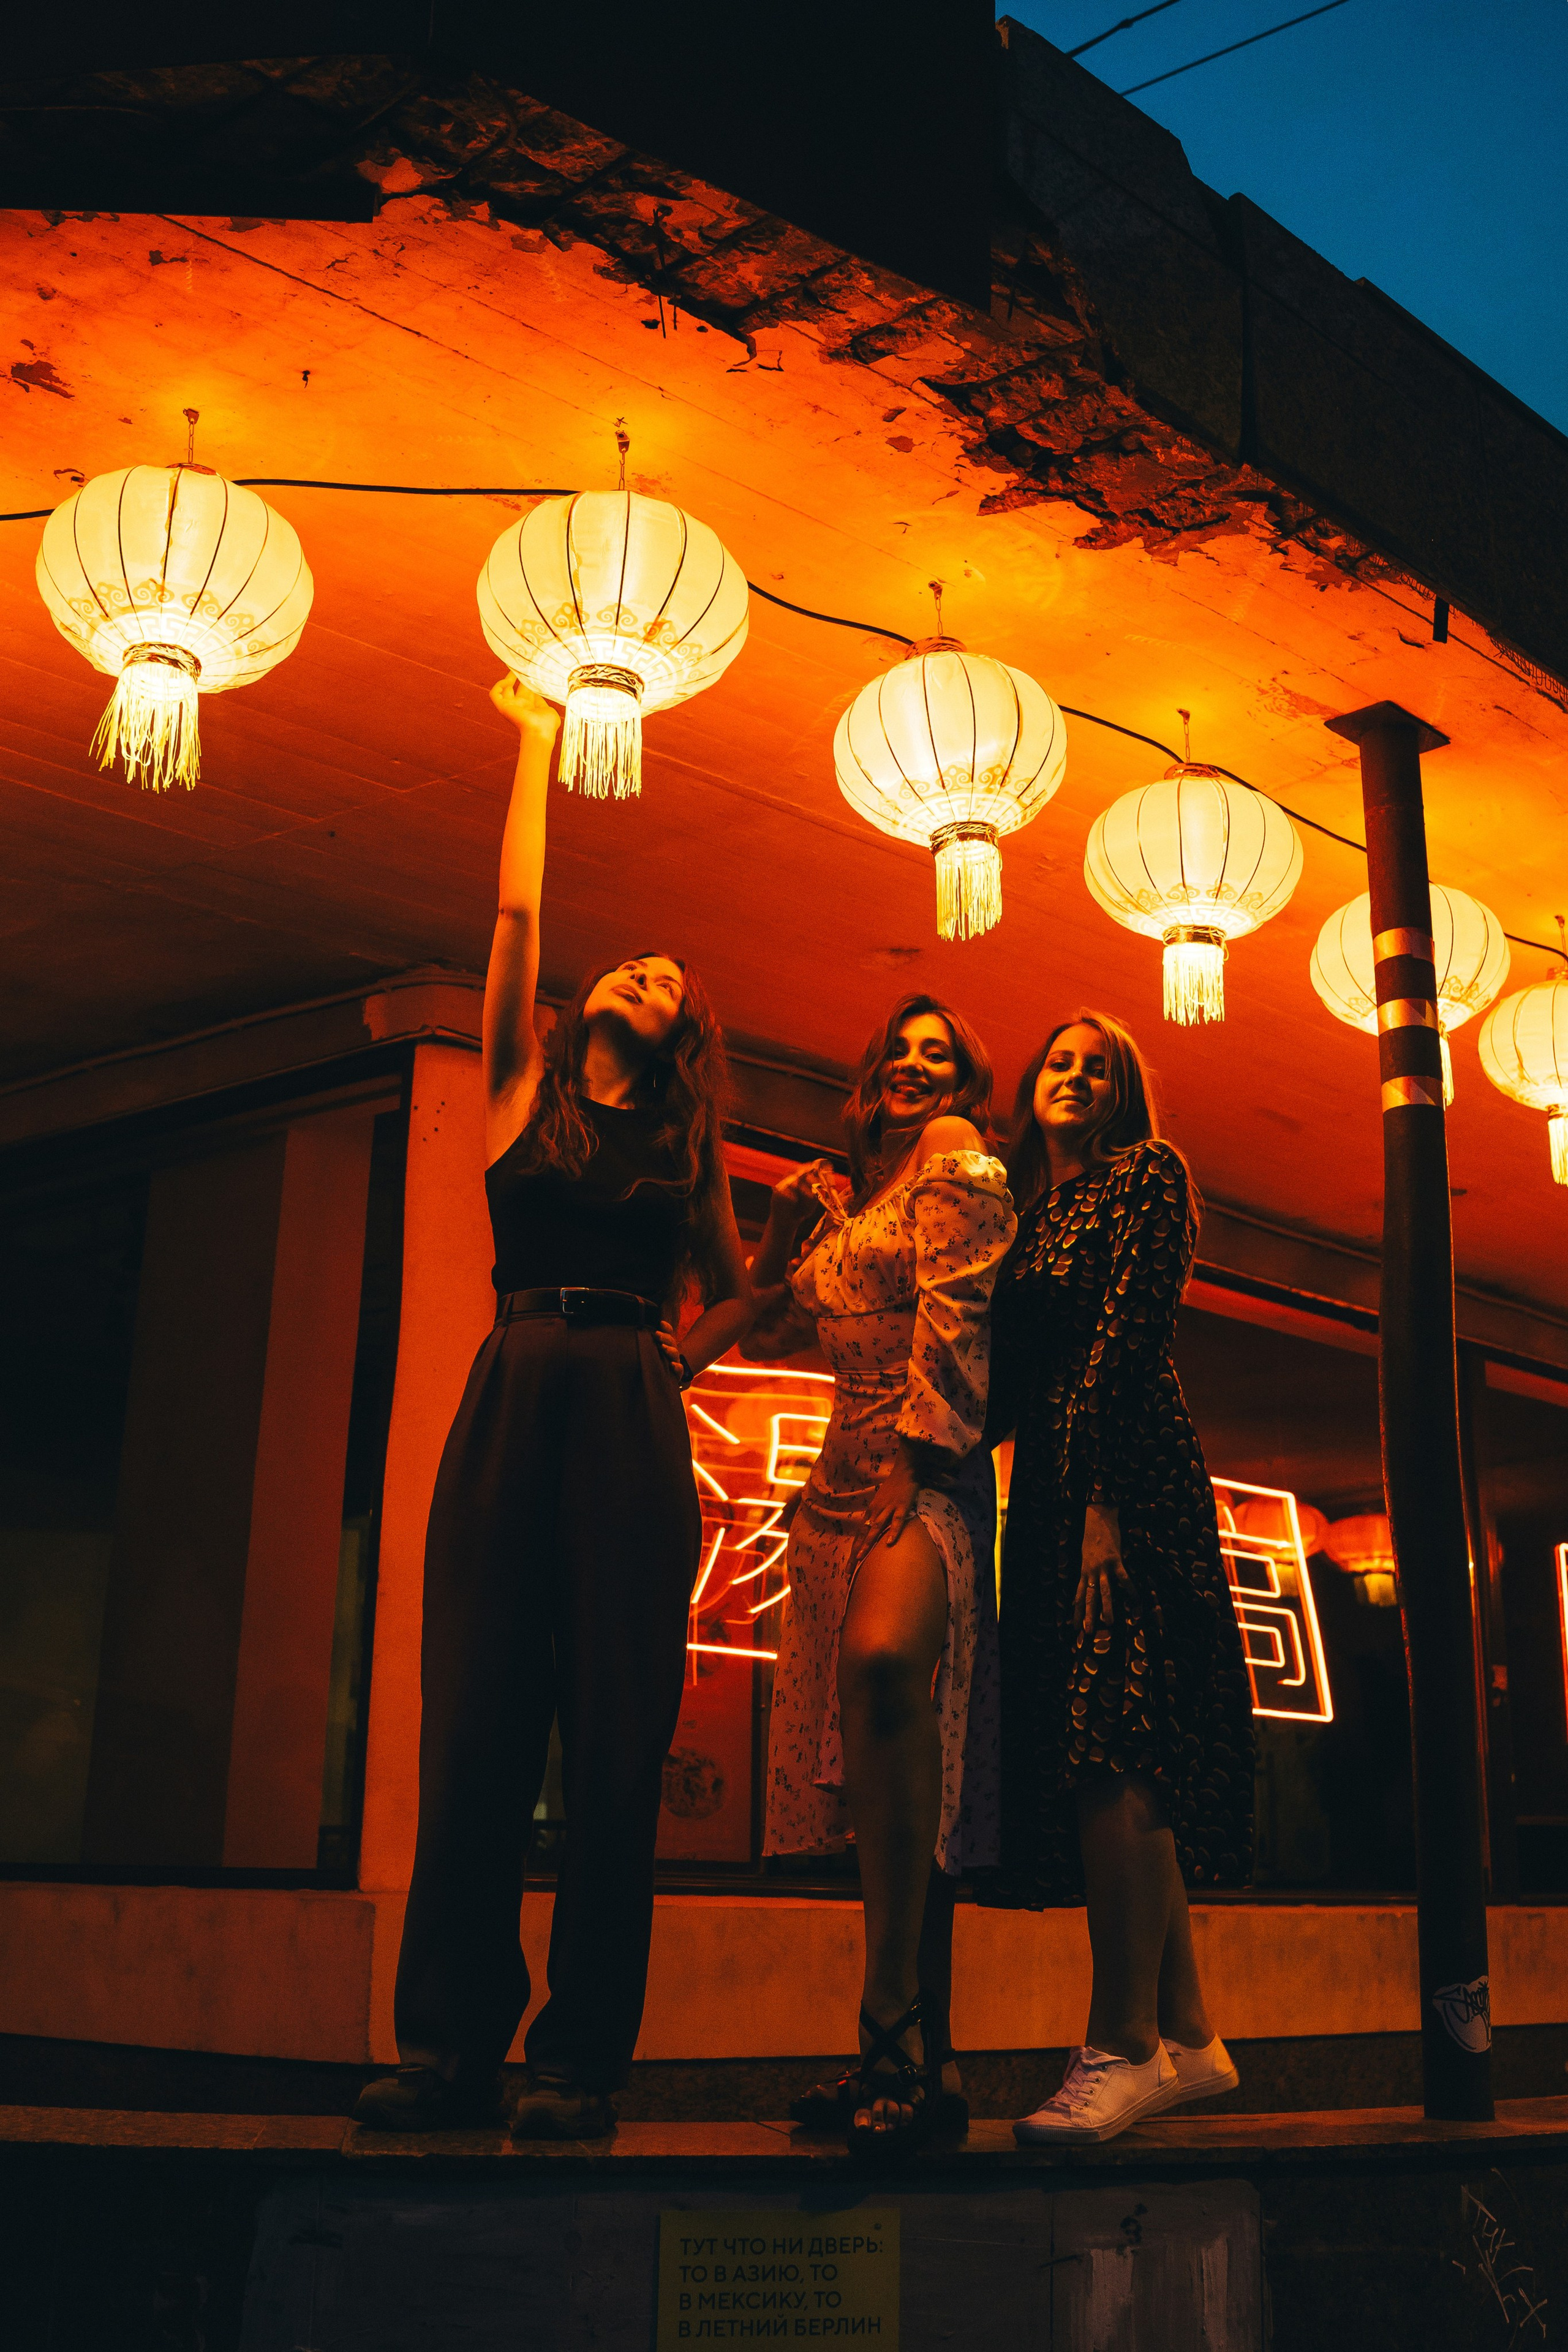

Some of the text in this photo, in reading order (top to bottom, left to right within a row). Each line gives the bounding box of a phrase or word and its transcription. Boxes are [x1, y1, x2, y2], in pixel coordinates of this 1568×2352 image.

[680, 2236, 883, 2258] ТУТ ЧТО НИ ДВЕРЬ:
[679, 2264, 838, 2284] ТО В АЗИЮ, ТО
[679, 2291, 842, 2311] В МЕКСИКУ, ТО
[679, 2313, 881, 2338] В ЛЕТНИЙ БЕРЛИН
